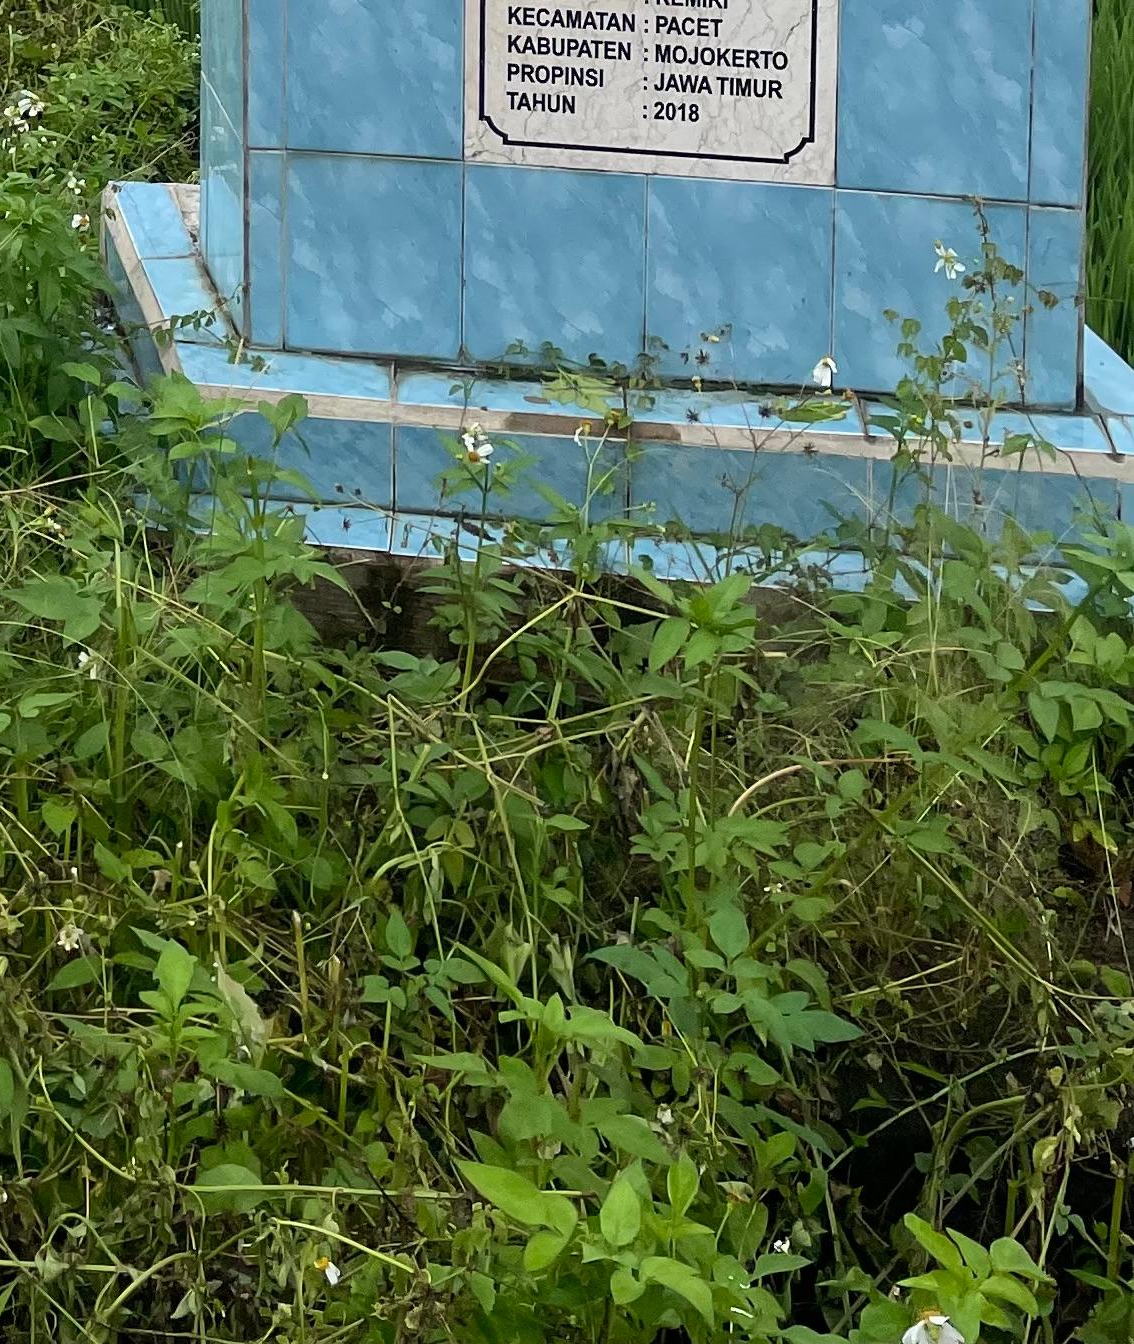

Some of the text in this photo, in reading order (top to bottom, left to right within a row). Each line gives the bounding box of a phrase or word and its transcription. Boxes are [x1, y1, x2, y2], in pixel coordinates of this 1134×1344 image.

[508, 7, 635, 32] KECAMATAN
[655, 16, 723, 38] PACET
[507, 35, 631, 60] KABUPATEN
[655, 45, 788, 70] MOJOKERTO
[507, 64, 604, 88] PROPINSI
[654, 74, 712, 95] JAWA
[716, 76, 783, 99] TIMUR
[506, 92, 575, 114] TAHUN
[654, 102, 699, 122] 2018
